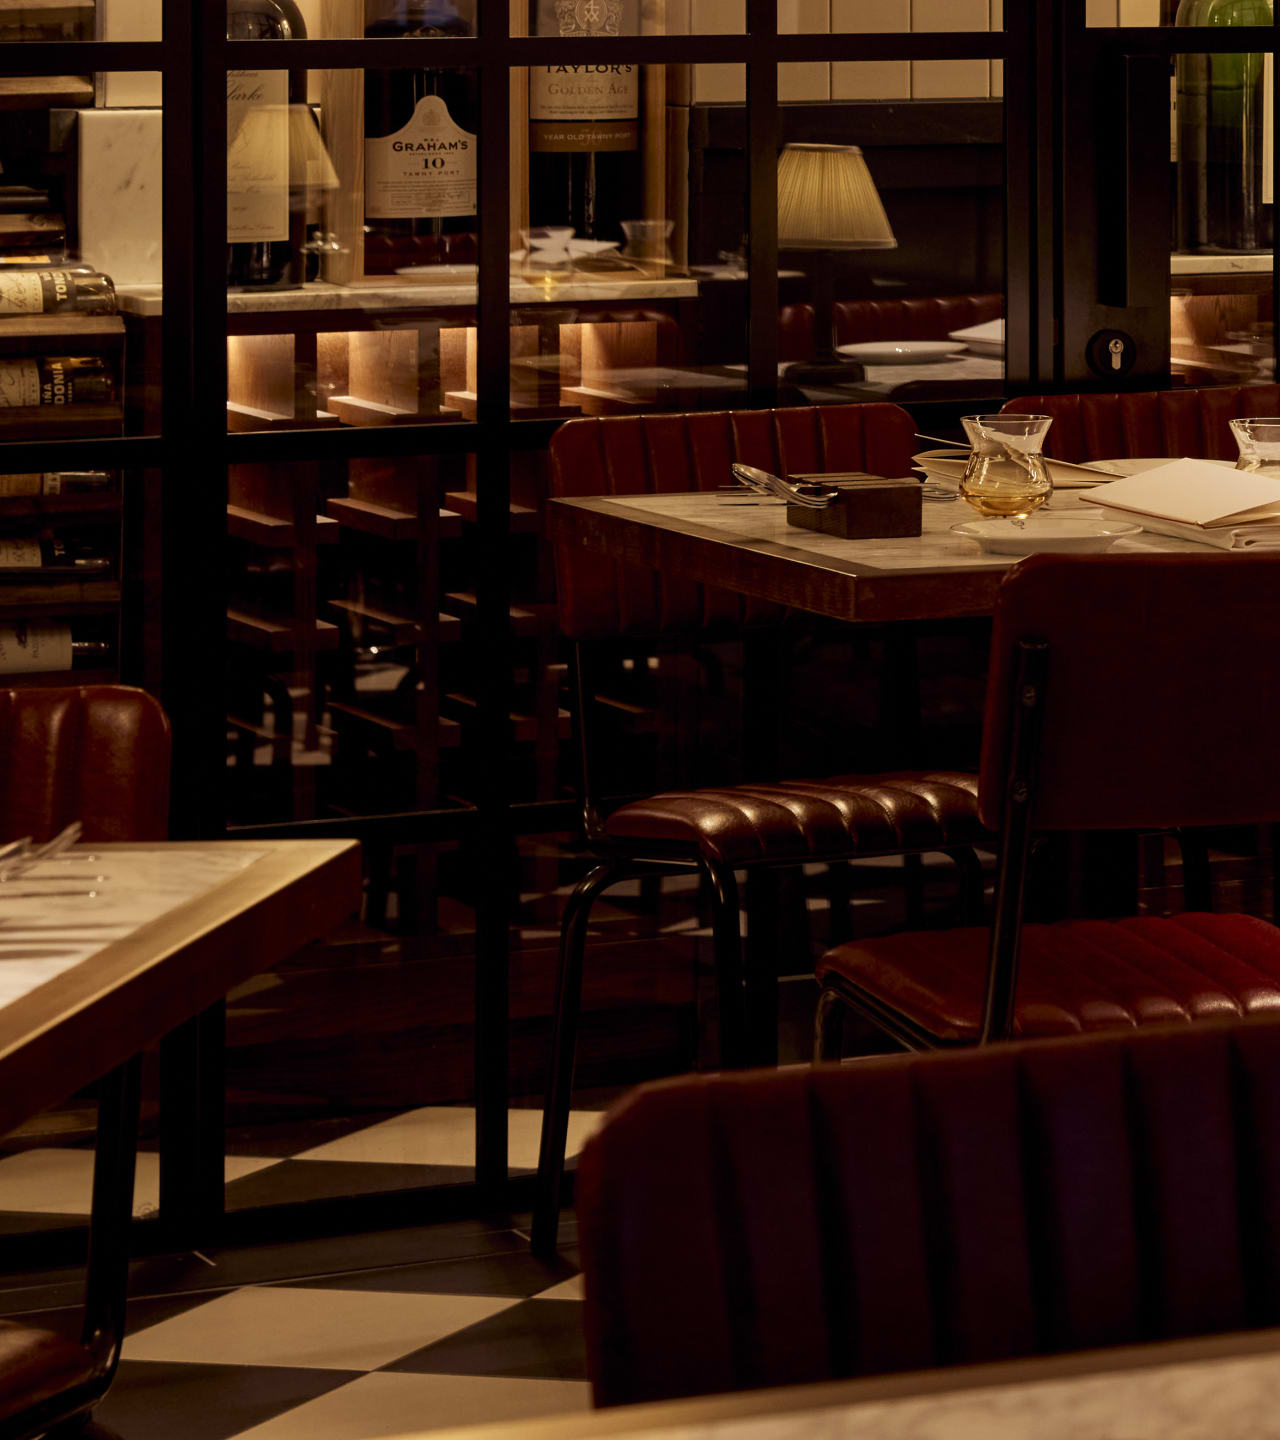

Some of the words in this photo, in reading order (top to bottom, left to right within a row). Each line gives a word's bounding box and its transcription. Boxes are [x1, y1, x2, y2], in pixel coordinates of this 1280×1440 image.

[566, 133, 585, 141] OLD
[614, 132, 631, 140] PORT
[392, 139, 469, 152] GRAHAM'S
[423, 157, 446, 170] 10
[437, 169, 461, 177] PORT
